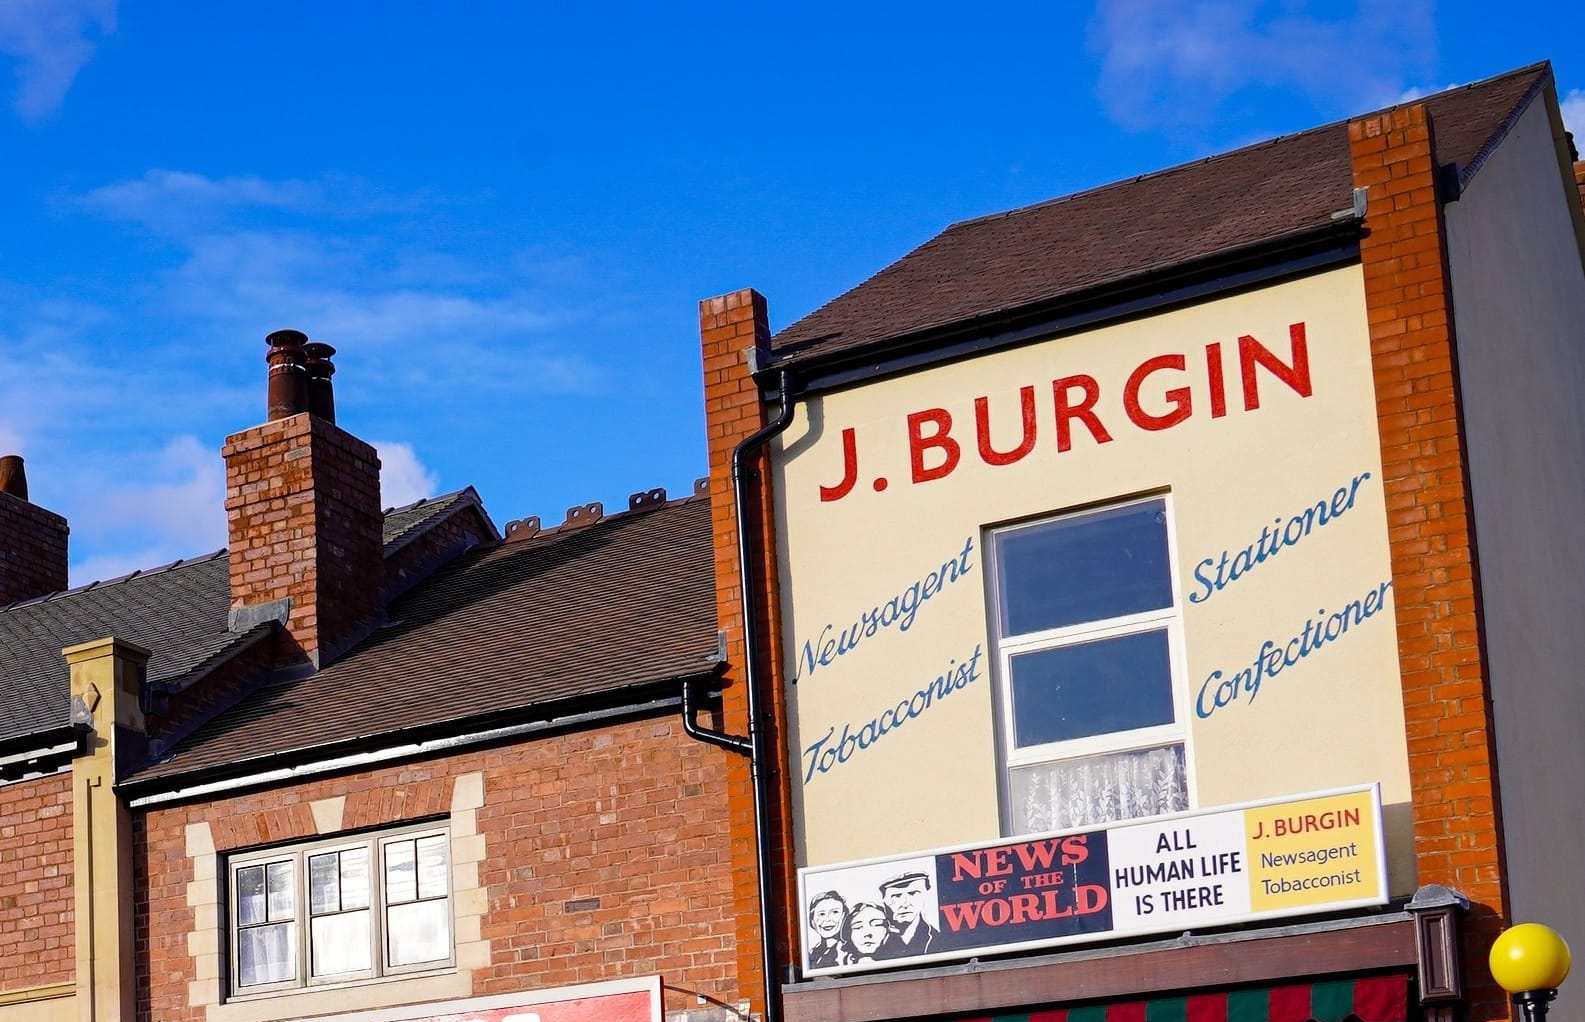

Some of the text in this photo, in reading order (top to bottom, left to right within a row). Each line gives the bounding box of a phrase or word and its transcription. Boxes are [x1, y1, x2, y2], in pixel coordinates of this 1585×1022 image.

[1189, 472, 1371, 603] Stationer
[792, 536, 974, 685] Newsagent
[1196, 580, 1393, 719] Confectioner
[802, 644, 982, 785] Tobacconist
[951, 834, 1089, 882] NEWS
[1155, 829, 1197, 855] ALL
[1261, 842, 1357, 868] Newsagent
[978, 871, 1064, 895] OF THE
[1115, 851, 1242, 889] HUMAN LIFE
[1261, 869, 1361, 895] Tobacconist
[940, 883, 1109, 932] WORLD
[1135, 889, 1224, 916] IS THERE
